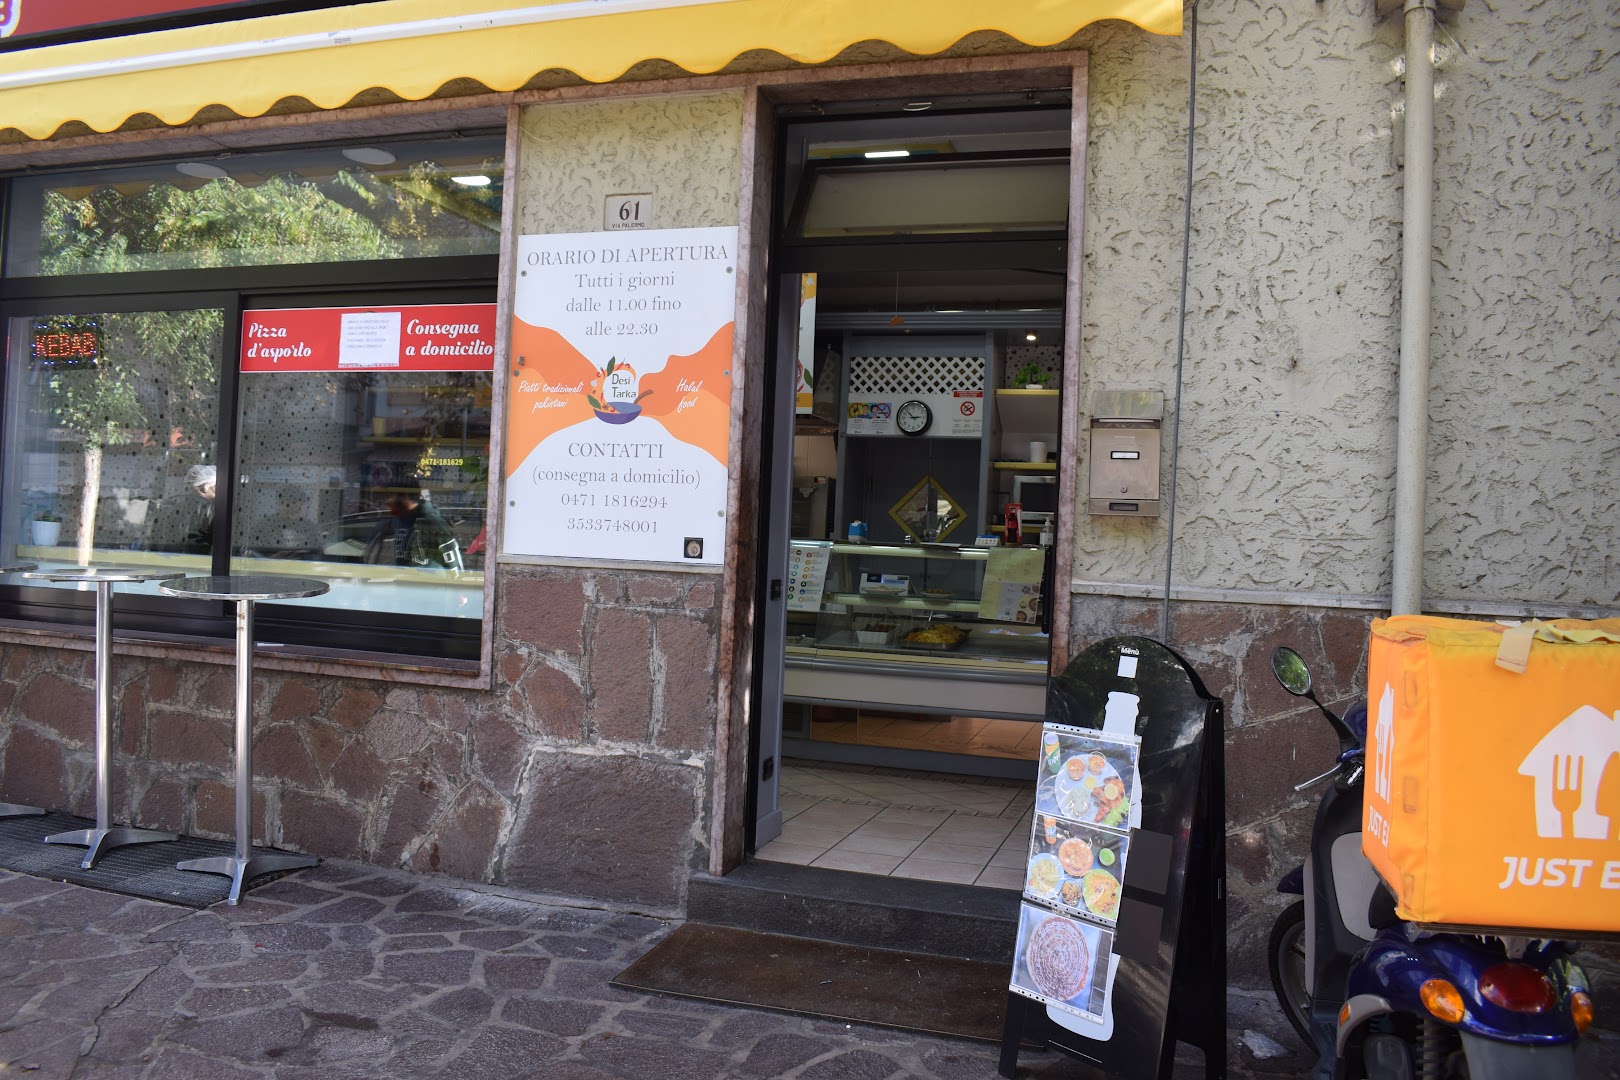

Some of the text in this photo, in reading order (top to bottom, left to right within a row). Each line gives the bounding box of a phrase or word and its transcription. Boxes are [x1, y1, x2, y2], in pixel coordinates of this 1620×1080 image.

[619, 201, 640, 221] 61
[527, 244, 729, 267] ORARIO DI APERTURA
[575, 271, 676, 291] Tutti i giorni
[566, 296, 682, 313] dalle 11.00 fino
[248, 322, 288, 338] Pizza
[406, 318, 481, 339] Consegna
[585, 320, 659, 336] alle 22.30
[36, 333, 95, 357] KEBAB
[247, 341, 313, 363] d'asporto
[405, 337, 494, 357] a domicilio
[519, 381, 584, 394] Piatti tradizionali
[611, 373, 631, 386] Desi
[676, 377, 703, 393] Halal
[611, 386, 637, 399] Tarka
[533, 399, 568, 413] pakistani
[677, 398, 697, 414] food
[568, 442, 664, 459] CONTATTI
[532, 465, 702, 490] (consegna a domicilio)
[561, 493, 669, 509] 0471 1816294
[567, 518, 659, 534] 3533748001
[1368, 804, 1383, 839] JUST
[1498, 856, 1594, 890] JUST
